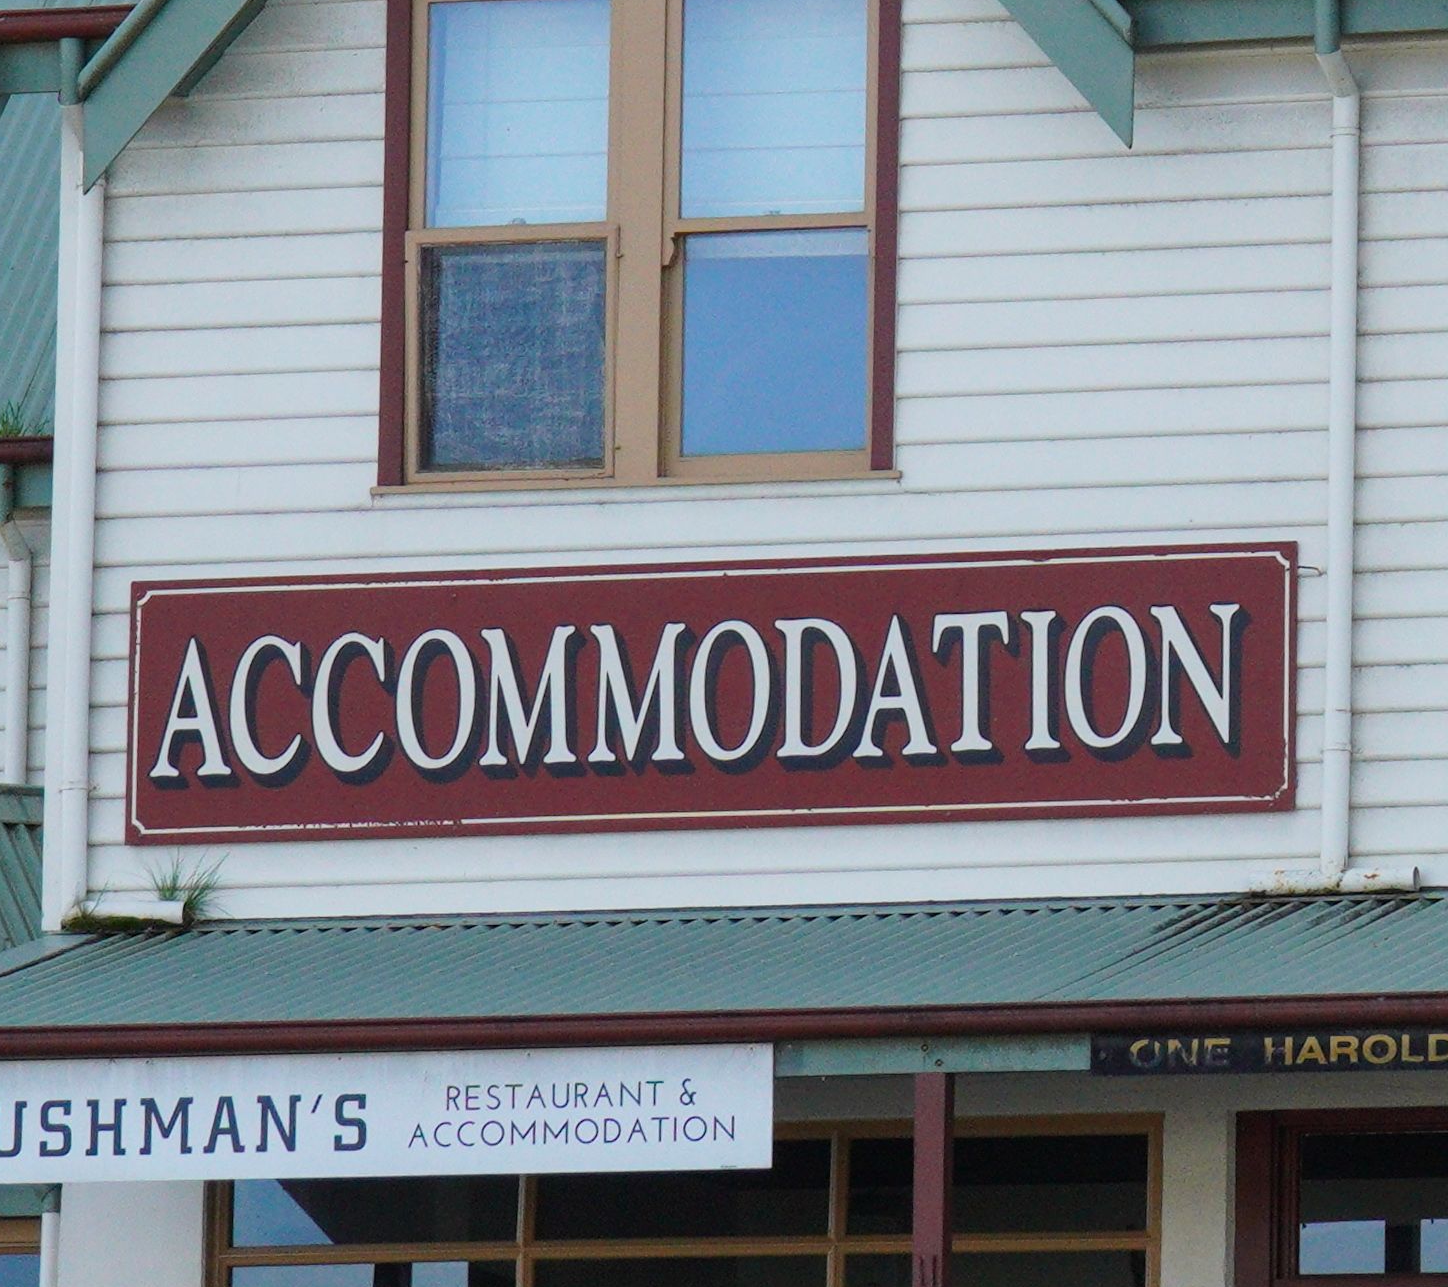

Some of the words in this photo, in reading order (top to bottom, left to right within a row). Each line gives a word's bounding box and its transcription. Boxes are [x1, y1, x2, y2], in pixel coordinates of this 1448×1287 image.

[149, 601, 1244, 779] ACCOMMODATION
[1129, 1037, 1231, 1070] ONE
[444, 1080, 665, 1113] RESTAURANT
[678, 1078, 699, 1108] &
[407, 1114, 739, 1150] ACCOMMODATION
